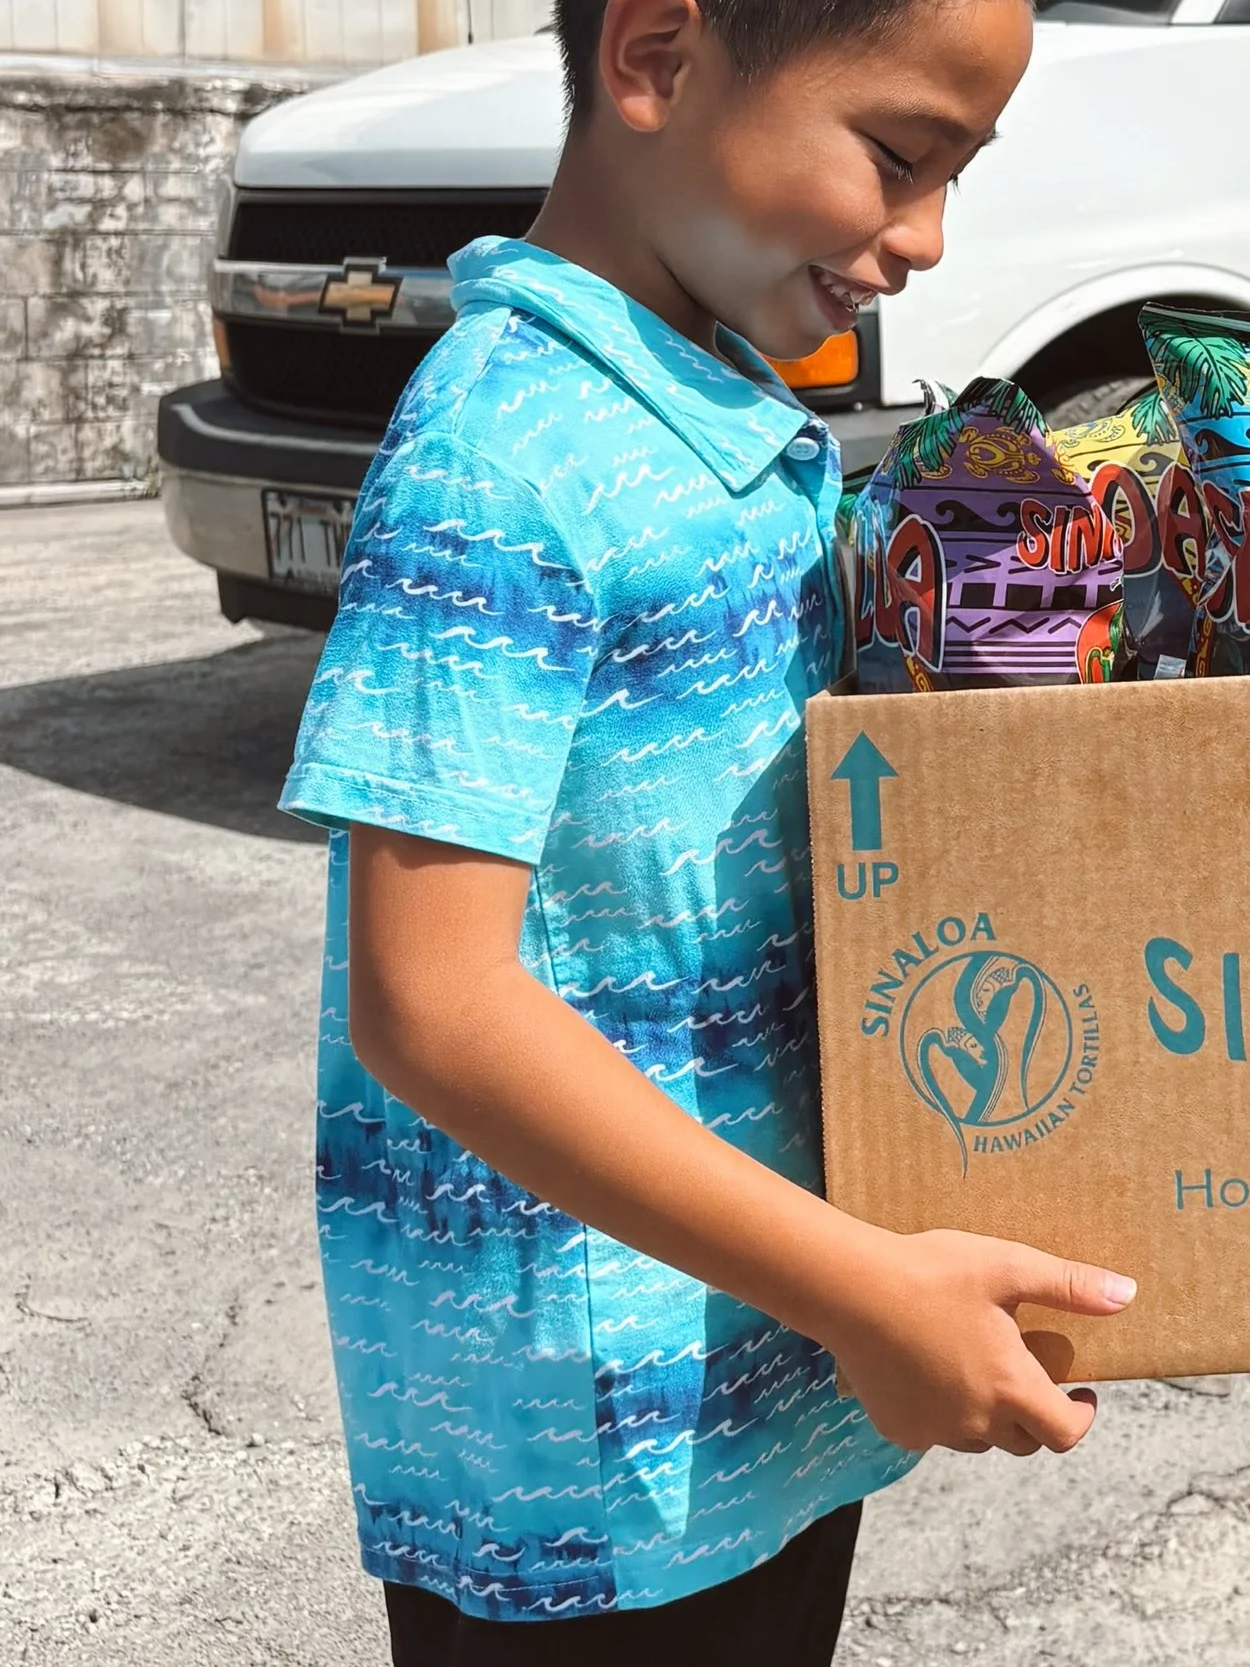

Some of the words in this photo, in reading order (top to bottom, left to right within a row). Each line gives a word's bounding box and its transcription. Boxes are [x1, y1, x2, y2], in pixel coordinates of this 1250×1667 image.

[836, 862, 900, 901] UP
[860, 912, 996, 1038] SINALOA
[973, 1098, 1075, 1154] HAWAIIAN
[1070, 983, 1101, 1097] TORTILLAS
